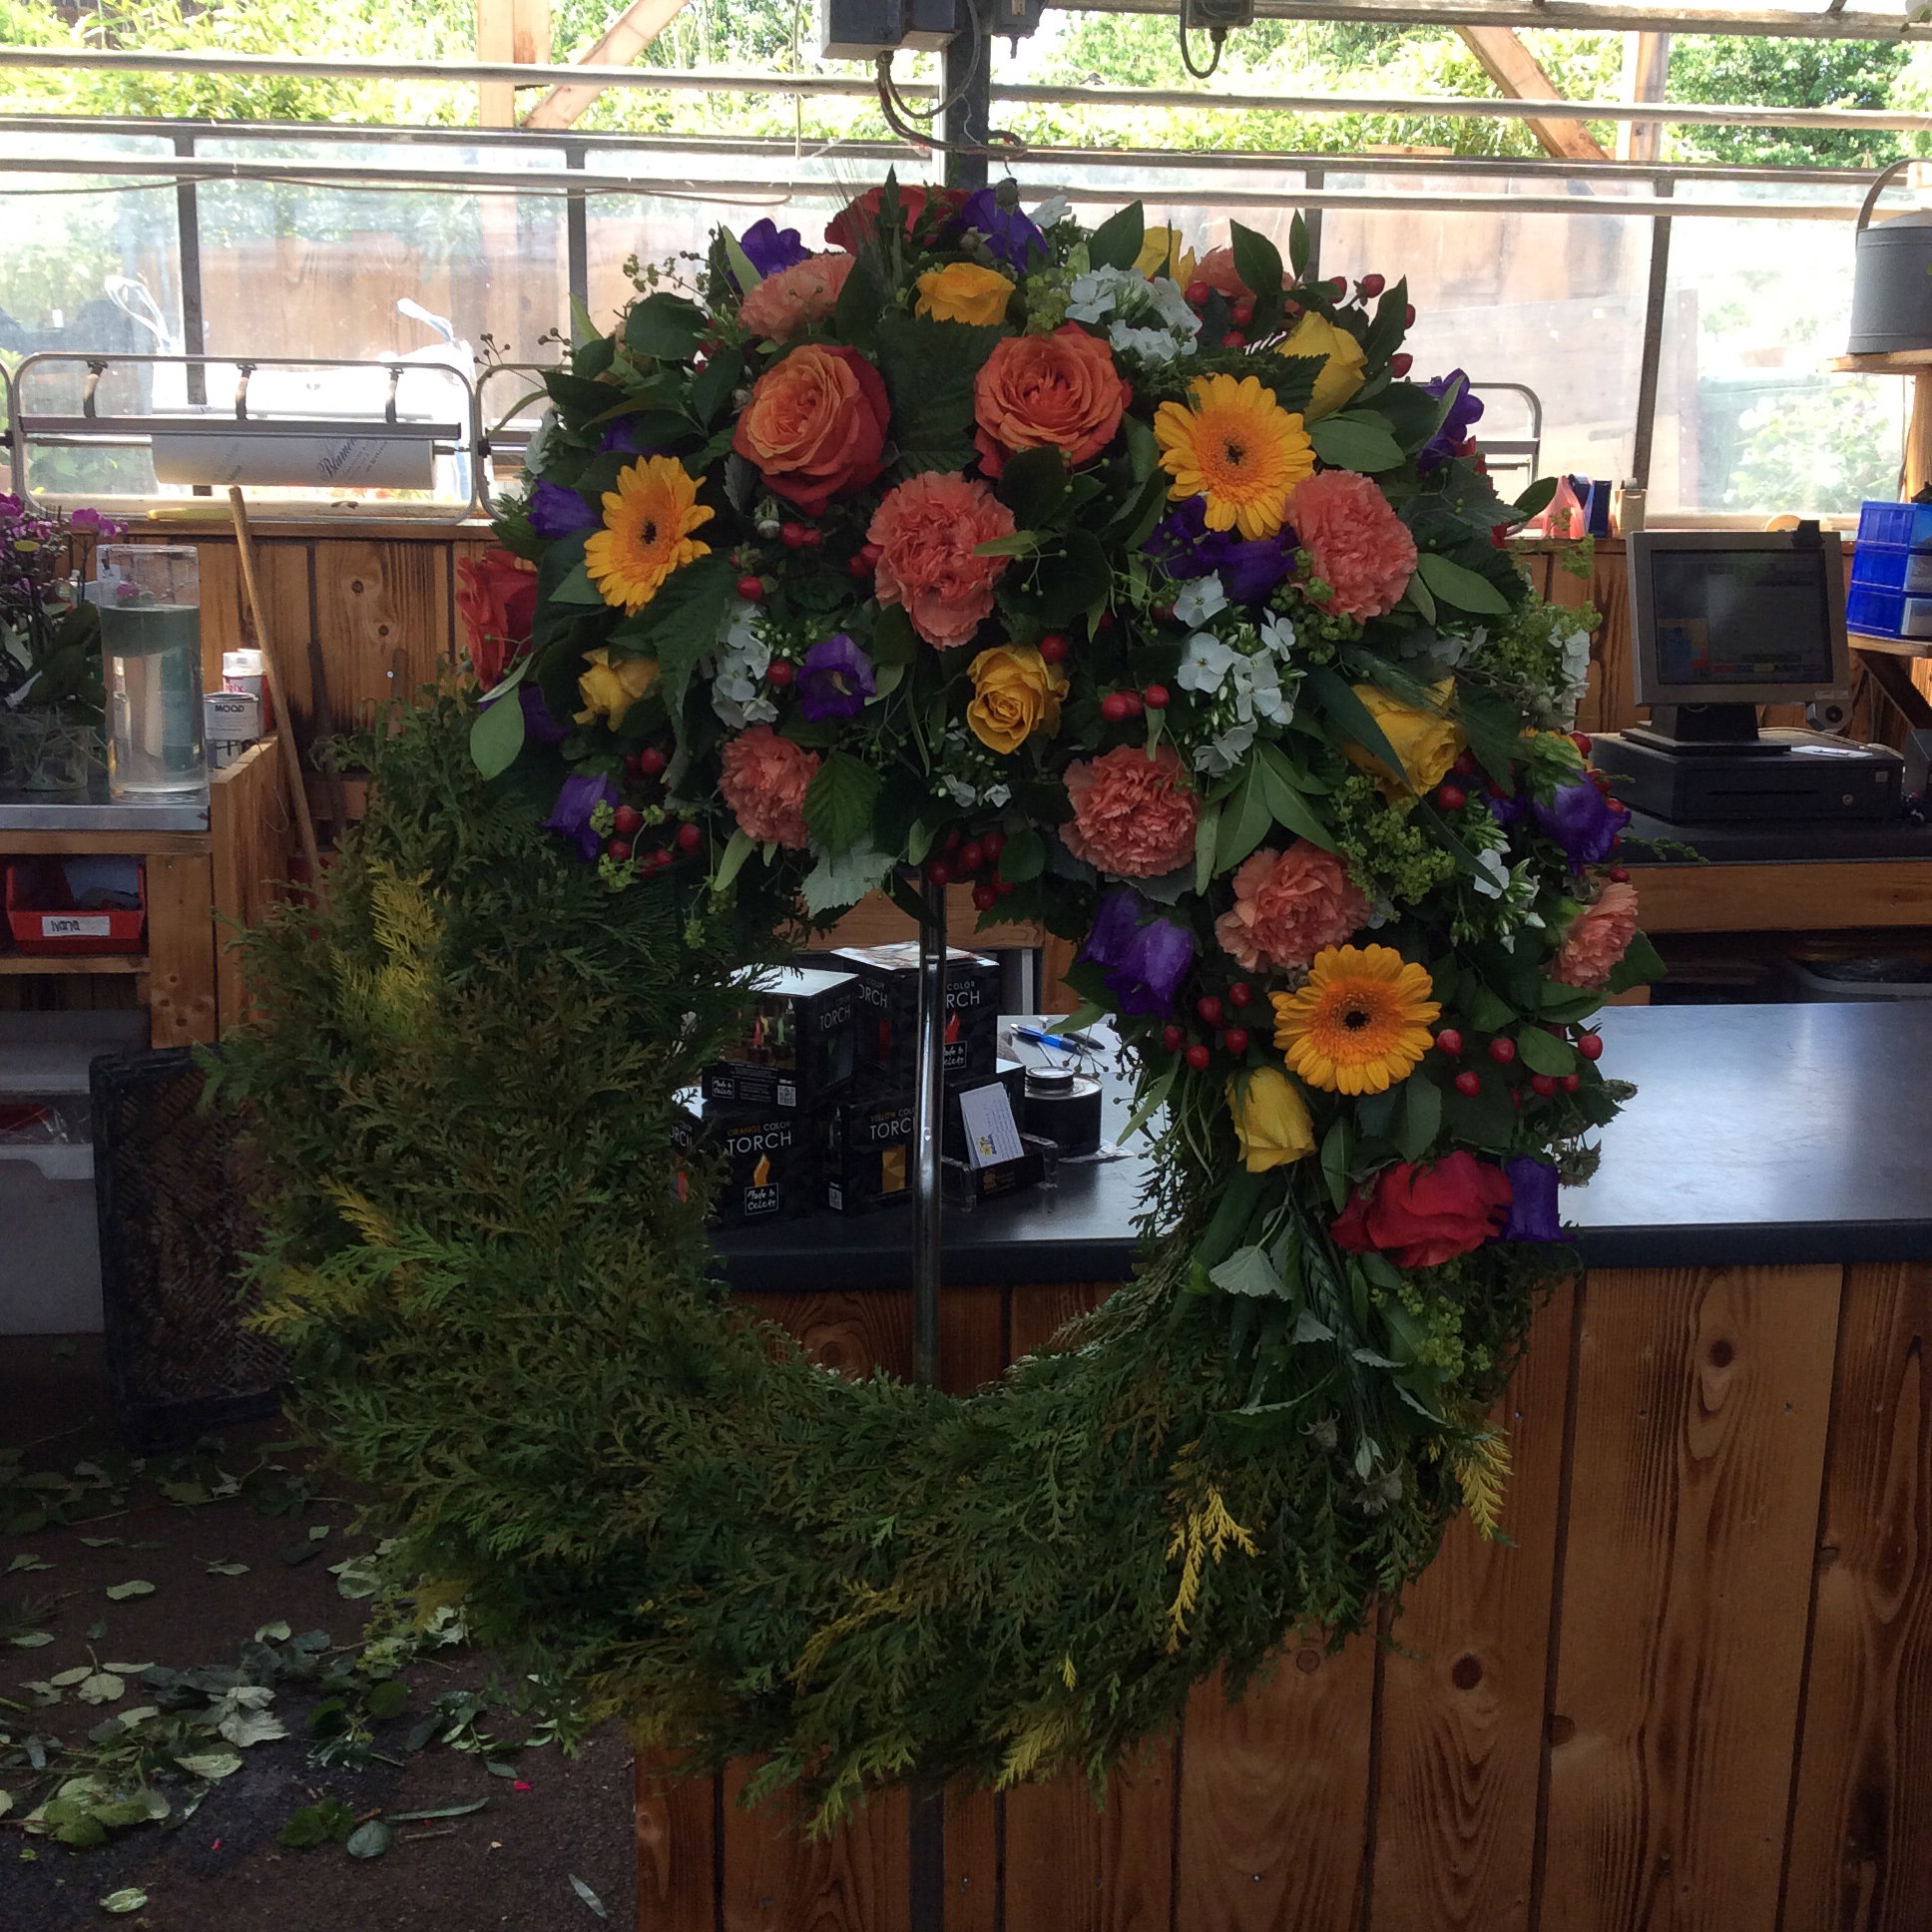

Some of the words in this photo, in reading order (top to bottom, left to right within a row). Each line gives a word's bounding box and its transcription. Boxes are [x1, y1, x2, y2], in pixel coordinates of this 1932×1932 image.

[215, 705, 245, 714] MOOD
[858, 983, 888, 1009] ORCH
[946, 980, 975, 991] COLOR
[946, 989, 980, 1009] RCH
[819, 1004, 851, 1031] TORCH
[897, 1106, 915, 1117] COL
[869, 1117, 916, 1141] TORC
[725, 1130, 792, 1156] TORCH
